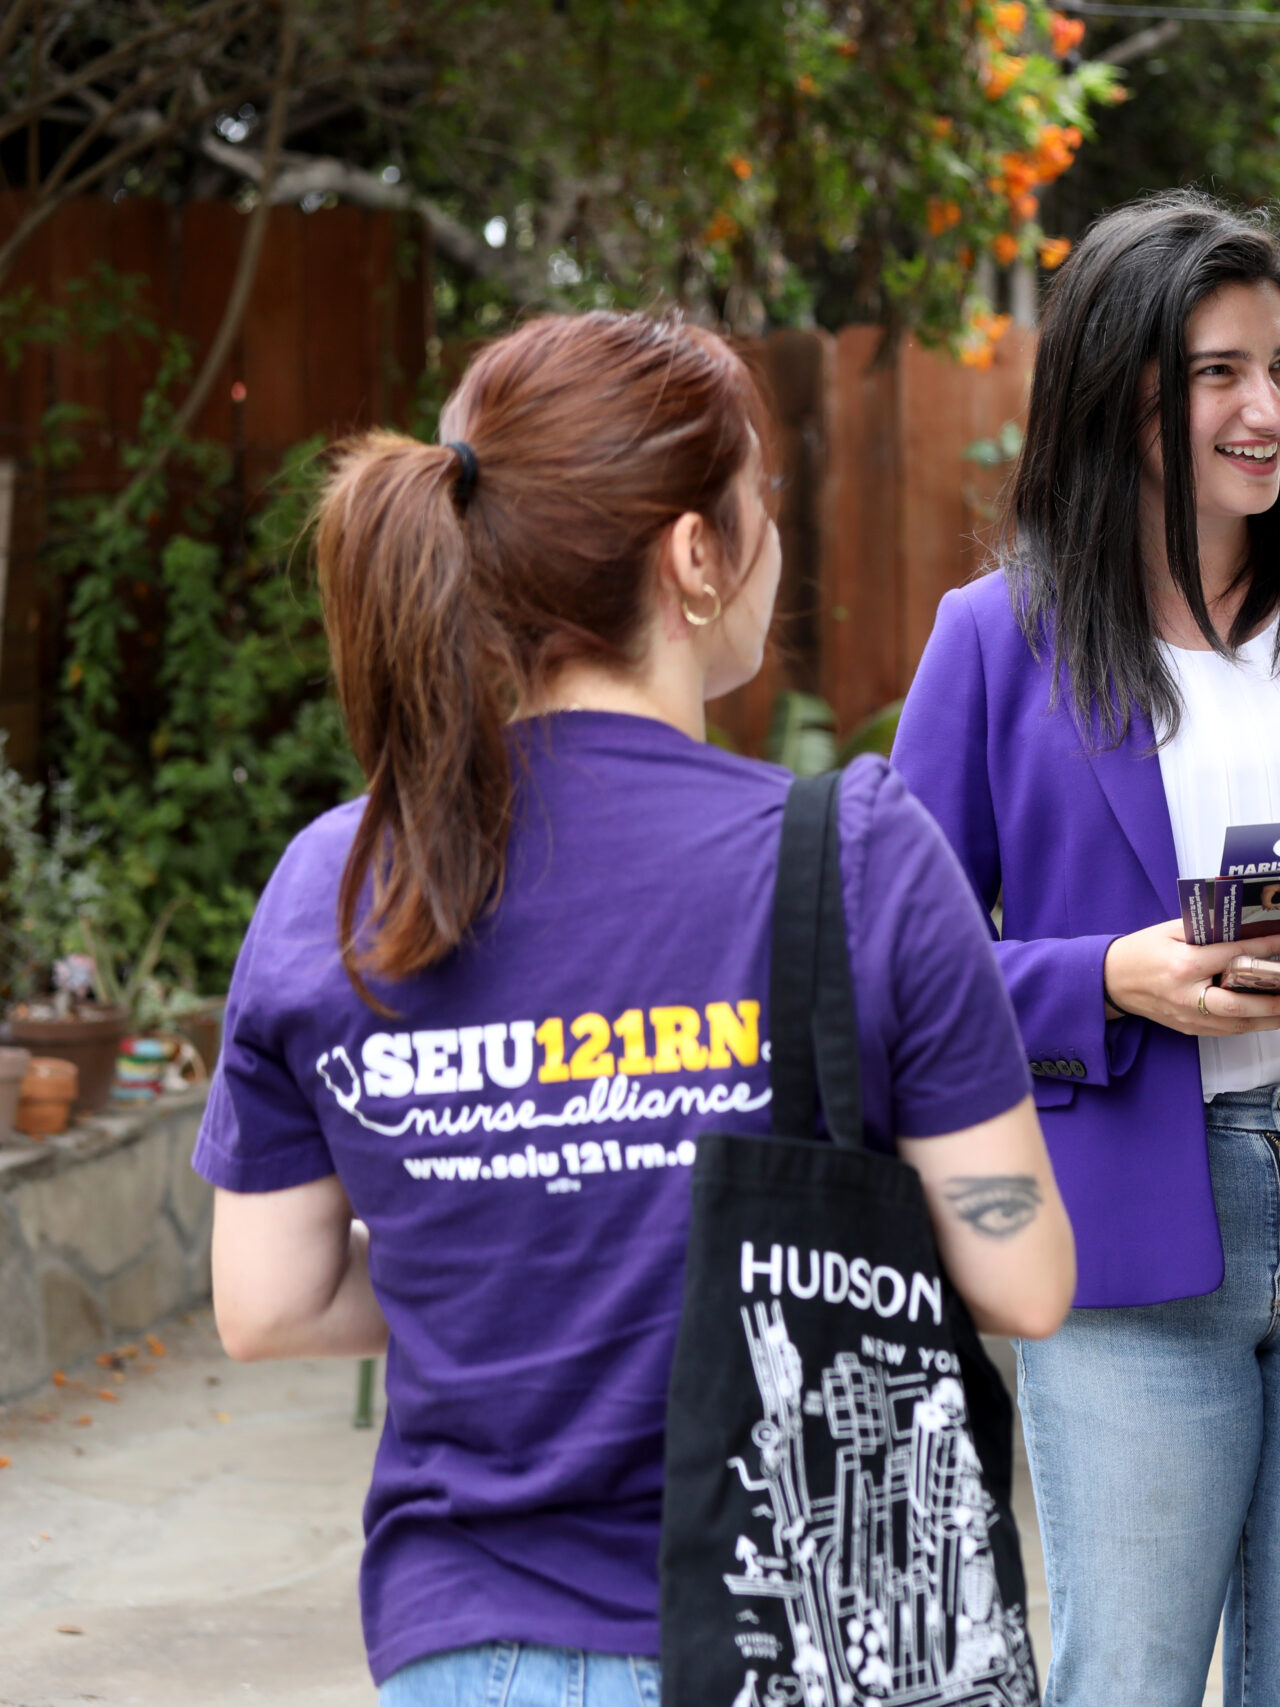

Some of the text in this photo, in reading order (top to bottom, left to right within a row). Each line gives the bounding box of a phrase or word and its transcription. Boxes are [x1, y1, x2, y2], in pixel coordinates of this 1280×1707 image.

[404, 1074, 770, 1137] nurse alliance
[403, 1139, 697, 1182] www.seiu121rn.o
[740, 1240, 943, 1326] HUDSON
[861, 1334, 961, 1376] NEW YO
